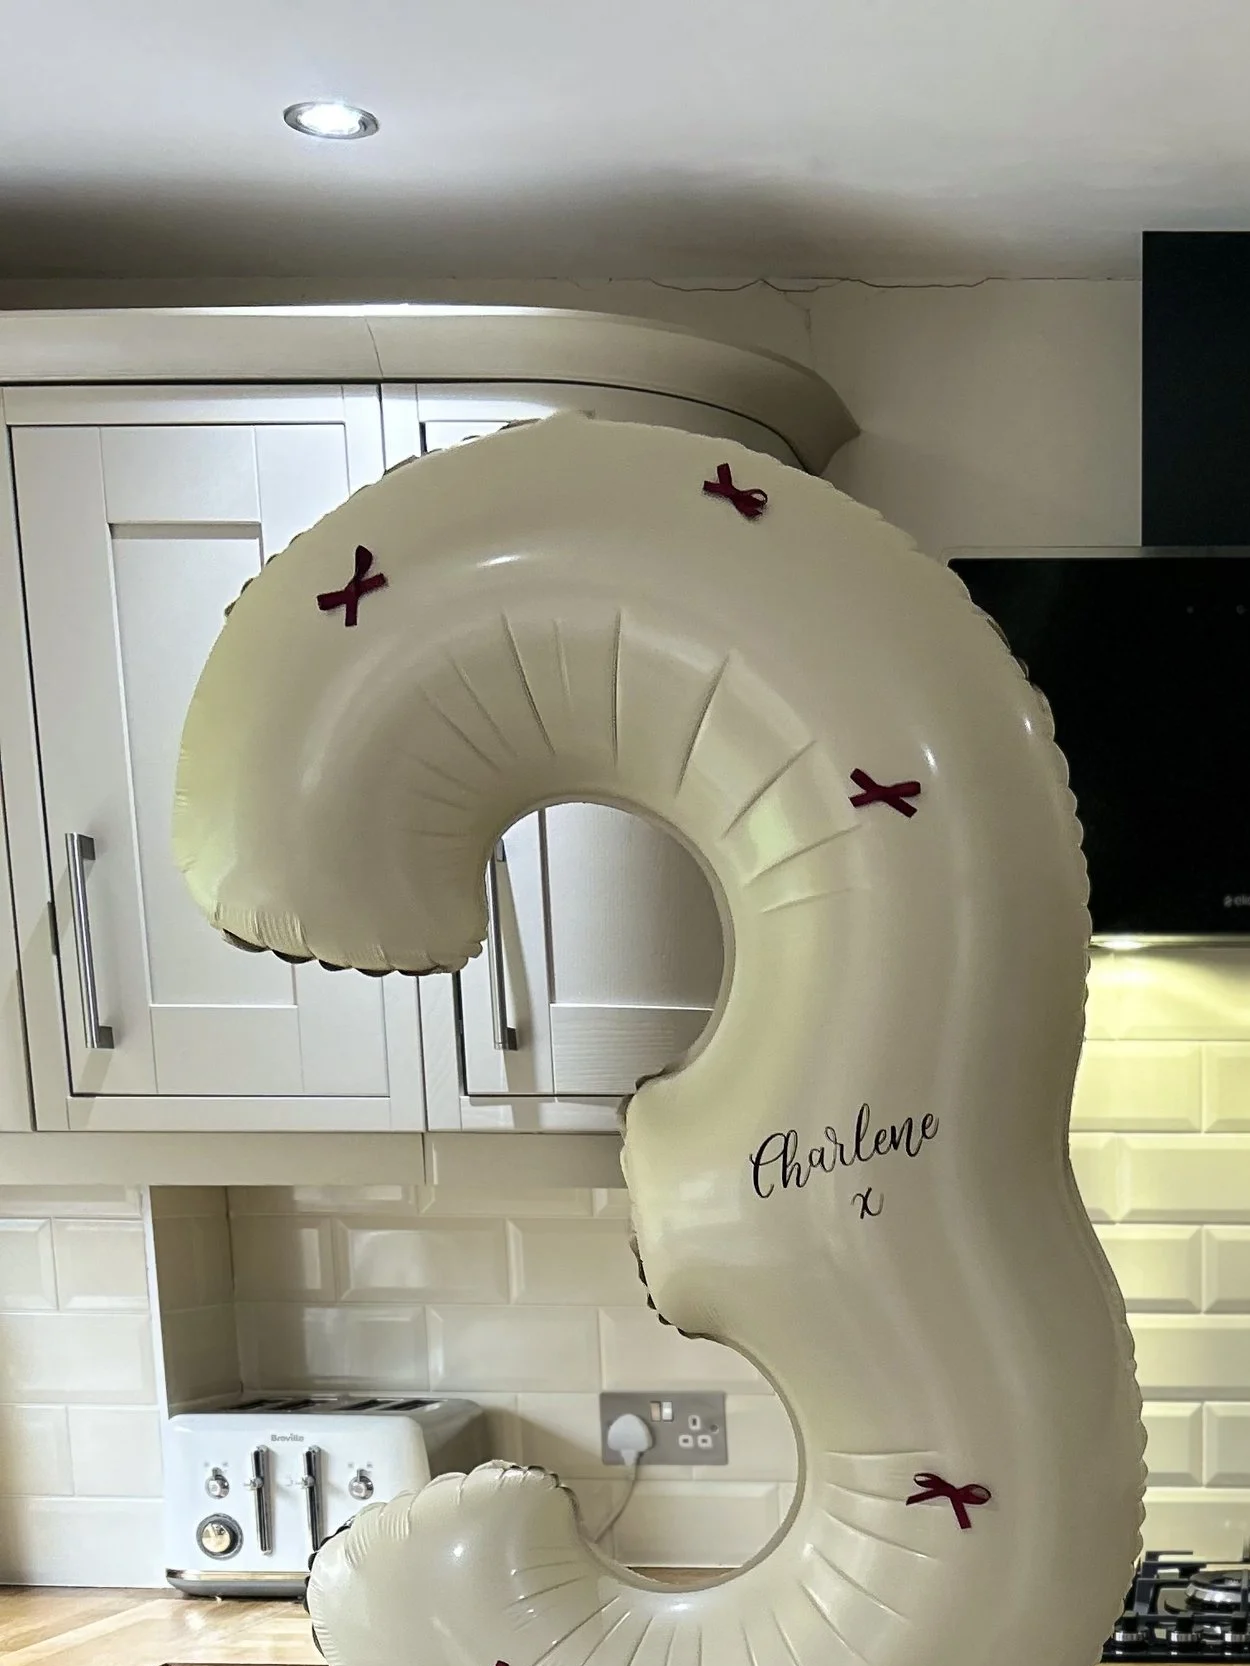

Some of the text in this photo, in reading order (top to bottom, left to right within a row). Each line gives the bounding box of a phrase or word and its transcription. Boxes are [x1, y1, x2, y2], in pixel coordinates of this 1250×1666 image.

[749, 1102, 940, 1199] Charlene
[850, 1186, 884, 1220] x
[271, 1433, 304, 1442] Breville
